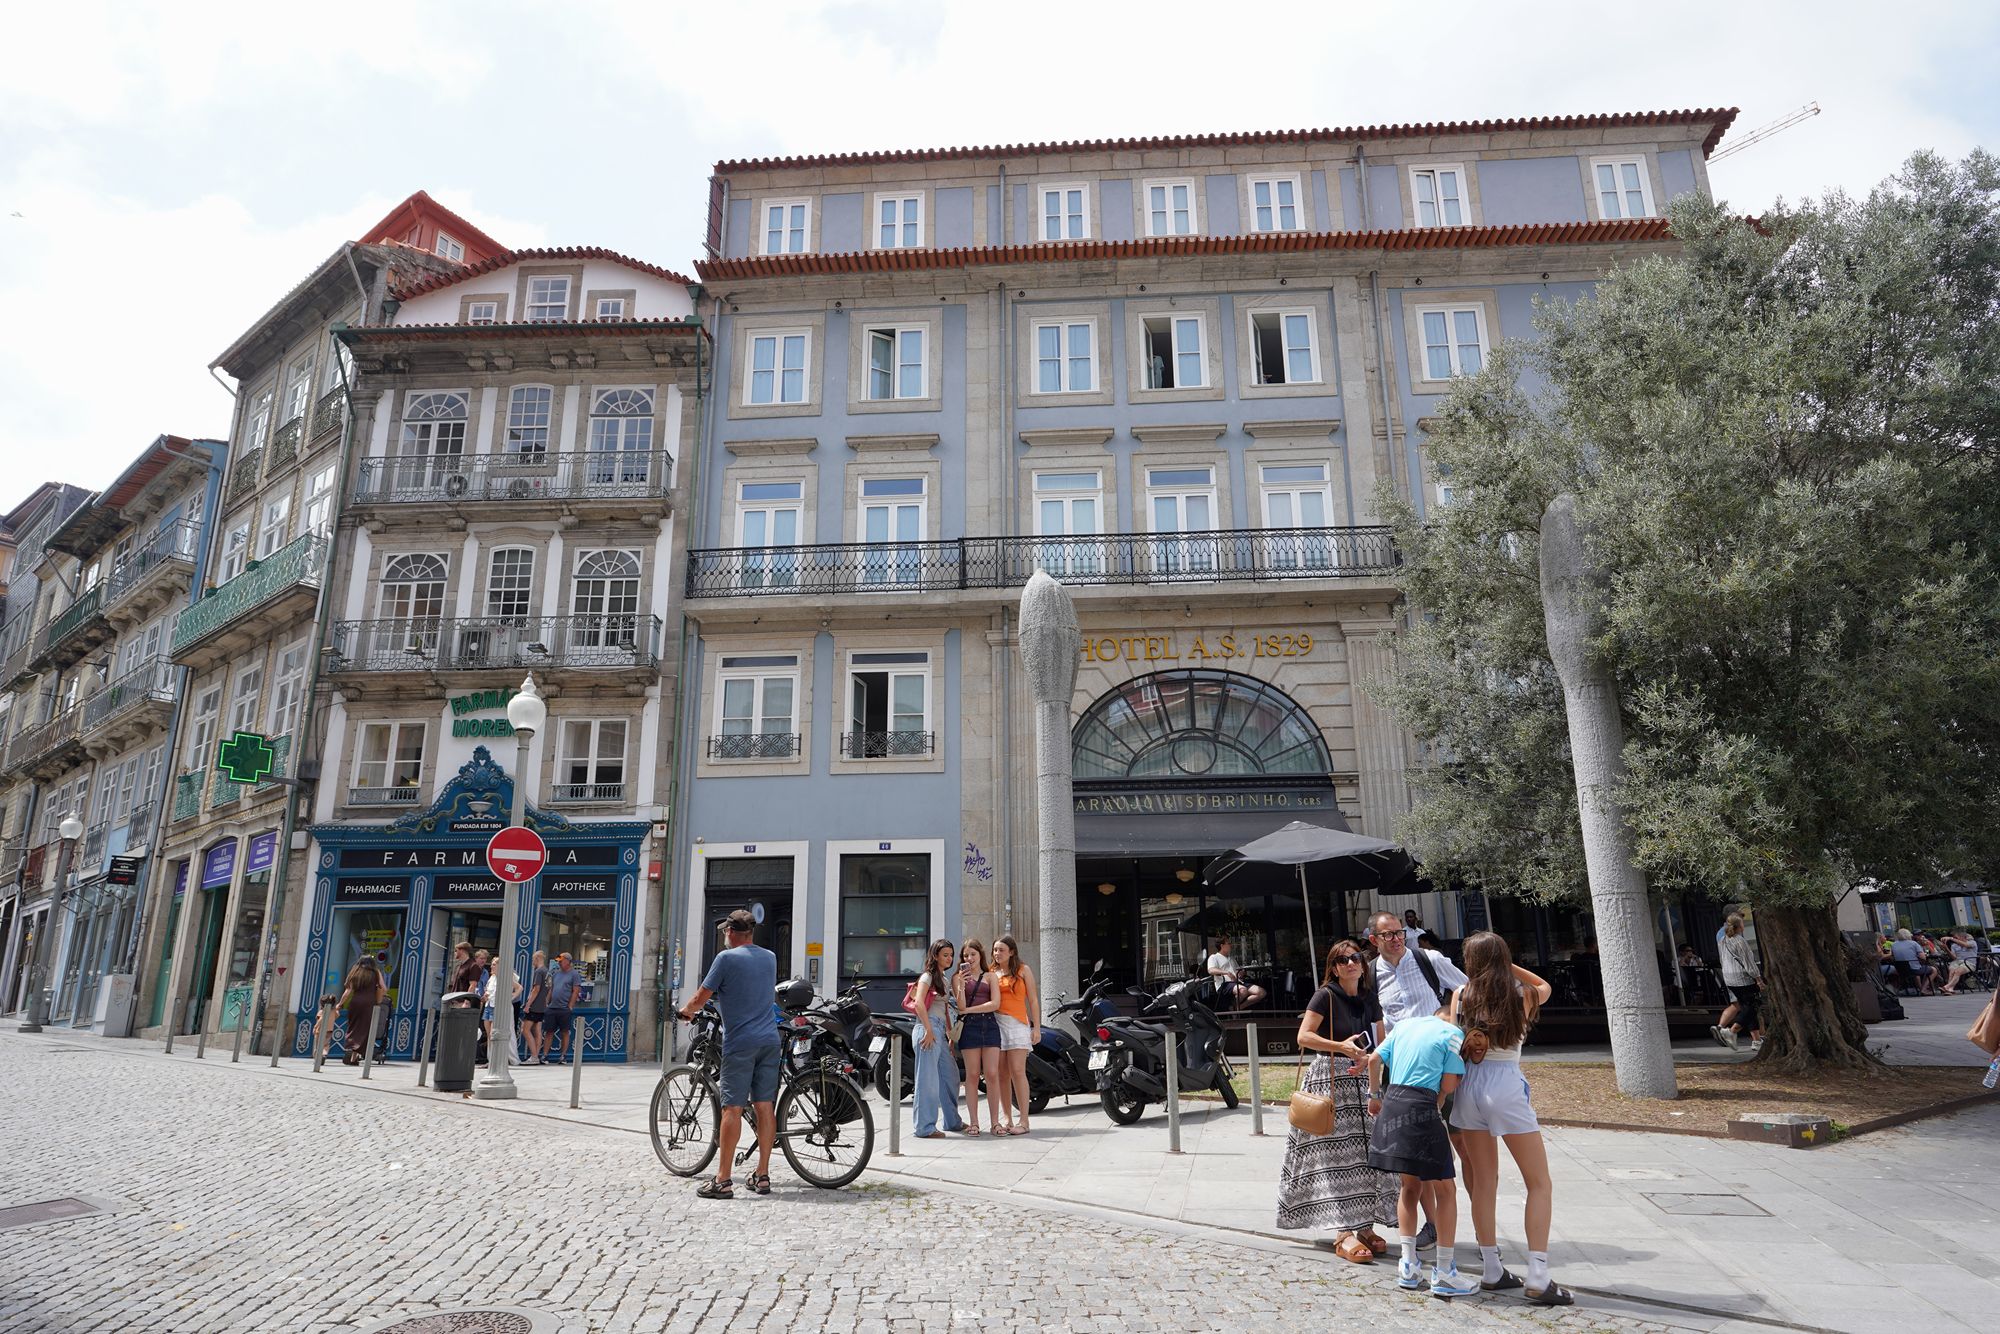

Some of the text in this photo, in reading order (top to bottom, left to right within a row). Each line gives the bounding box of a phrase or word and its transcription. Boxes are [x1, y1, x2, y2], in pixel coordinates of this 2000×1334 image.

[1080, 632, 1314, 662] HOTEL A.S. 1829
[450, 687, 520, 716] FARMÁ
[452, 718, 516, 738] MOREN
[1164, 796, 1174, 809] &
[383, 850, 577, 865] FARMIA
[344, 885, 401, 894] PHARMACIE
[448, 883, 503, 892] PHARMACY
[552, 882, 606, 891] APOTHEKE
